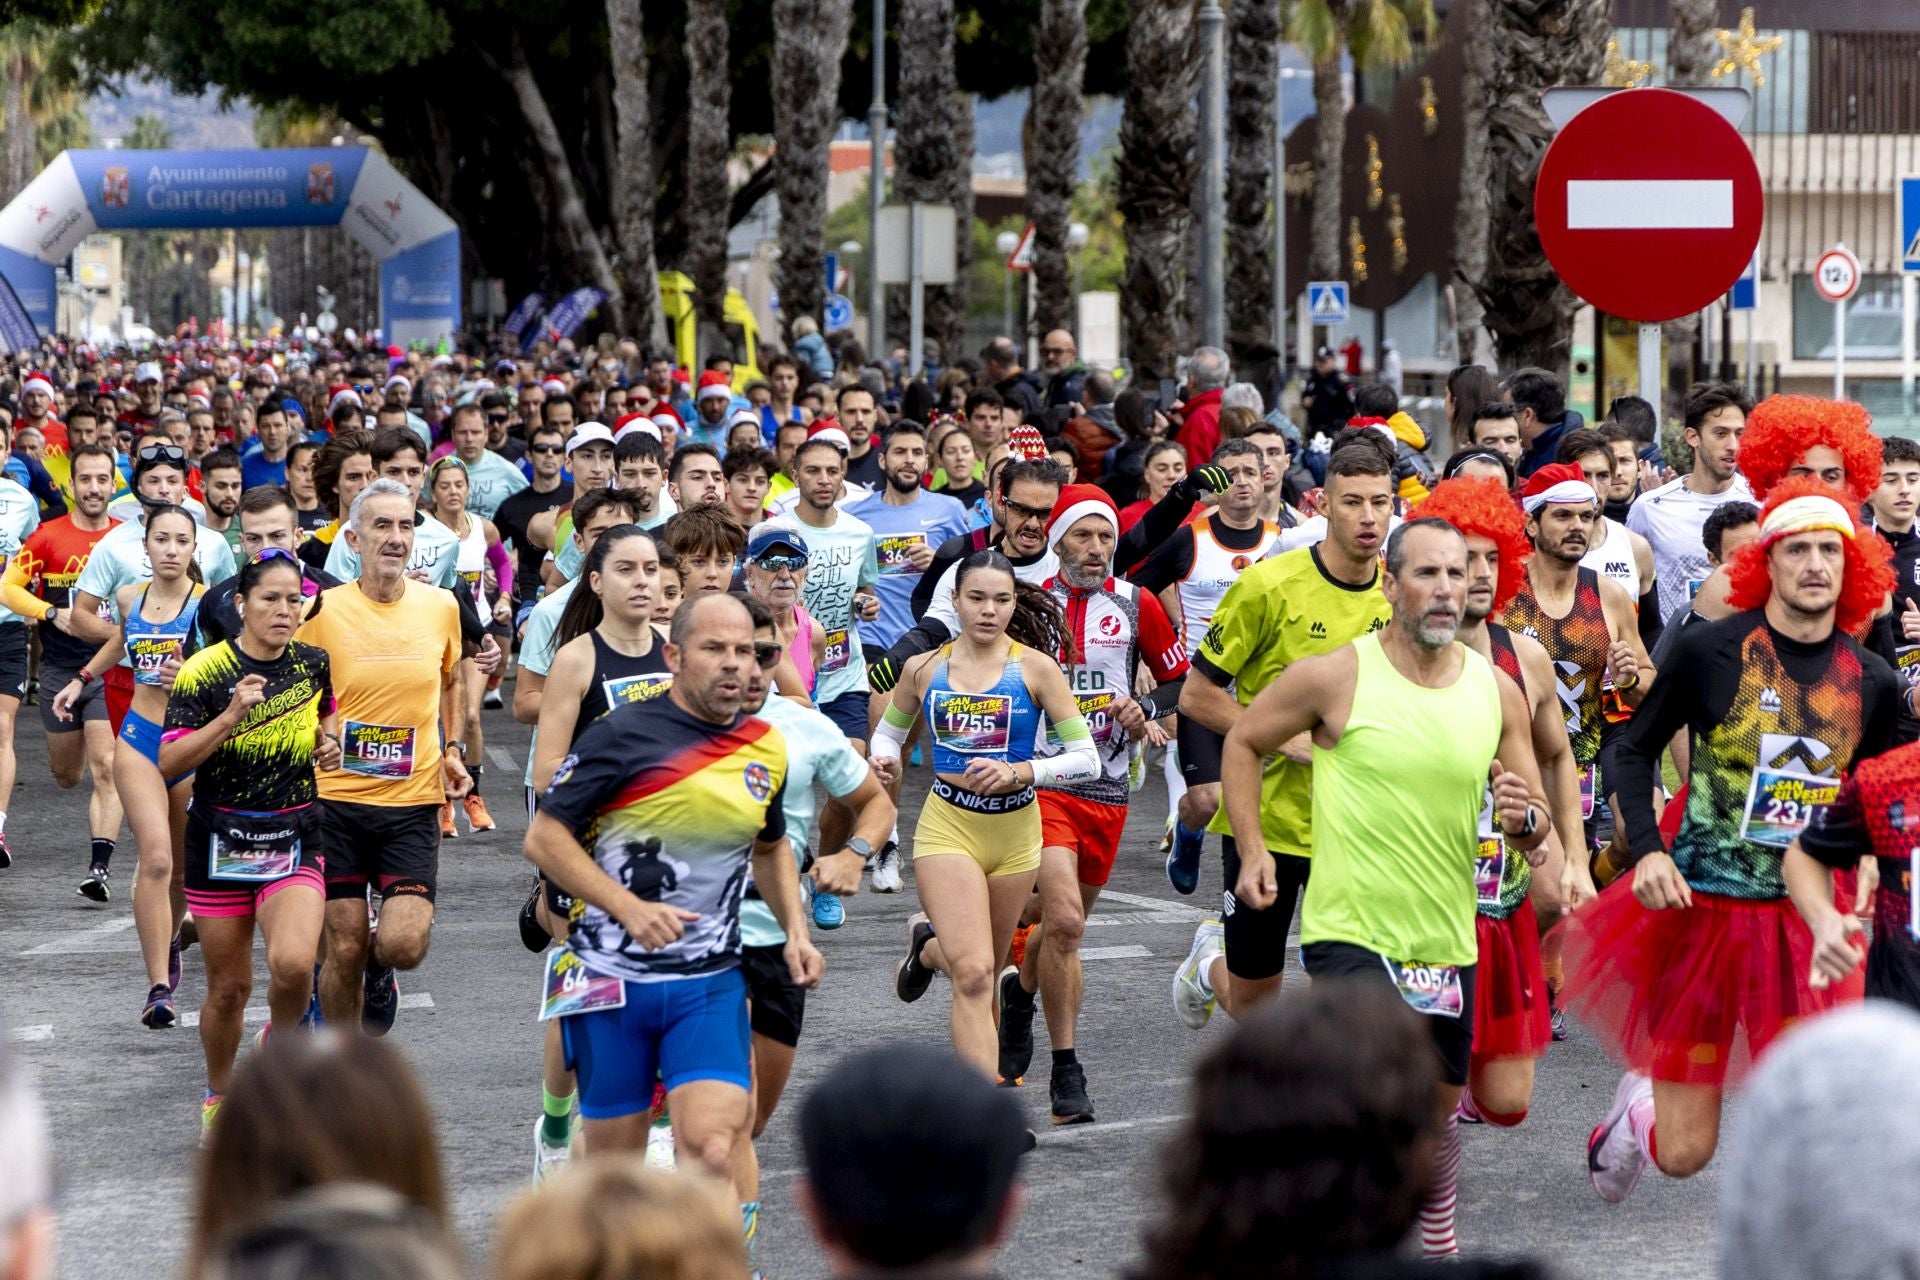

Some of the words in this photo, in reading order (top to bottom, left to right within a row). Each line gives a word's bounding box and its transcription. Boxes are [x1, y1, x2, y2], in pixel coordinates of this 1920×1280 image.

[149, 165, 288, 185] Ayuntamiento
[146, 184, 287, 214] Cartagena
[885, 549, 912, 564] 36
[824, 646, 843, 660] 83
[1161, 640, 1188, 671] UN
[626, 681, 649, 693] SAN
[232, 678, 313, 737] LUMBRES
[948, 699, 1004, 714] SILVESTRE
[949, 697, 971, 706] SAN
[243, 699, 320, 753] SPORT
[945, 713, 996, 733] 1755
[358, 729, 410, 743] SILVESTRE
[356, 740, 402, 761] 1505
[1065, 771, 1093, 781] LURBEL
[933, 779, 952, 798] RO
[954, 791, 1003, 811] NIKE
[1004, 785, 1035, 807] PRO
[1775, 780, 1805, 794] SAN
[1764, 797, 1828, 829] 231
[246, 829, 295, 841] LURBEL
[562, 965, 590, 992] 64
